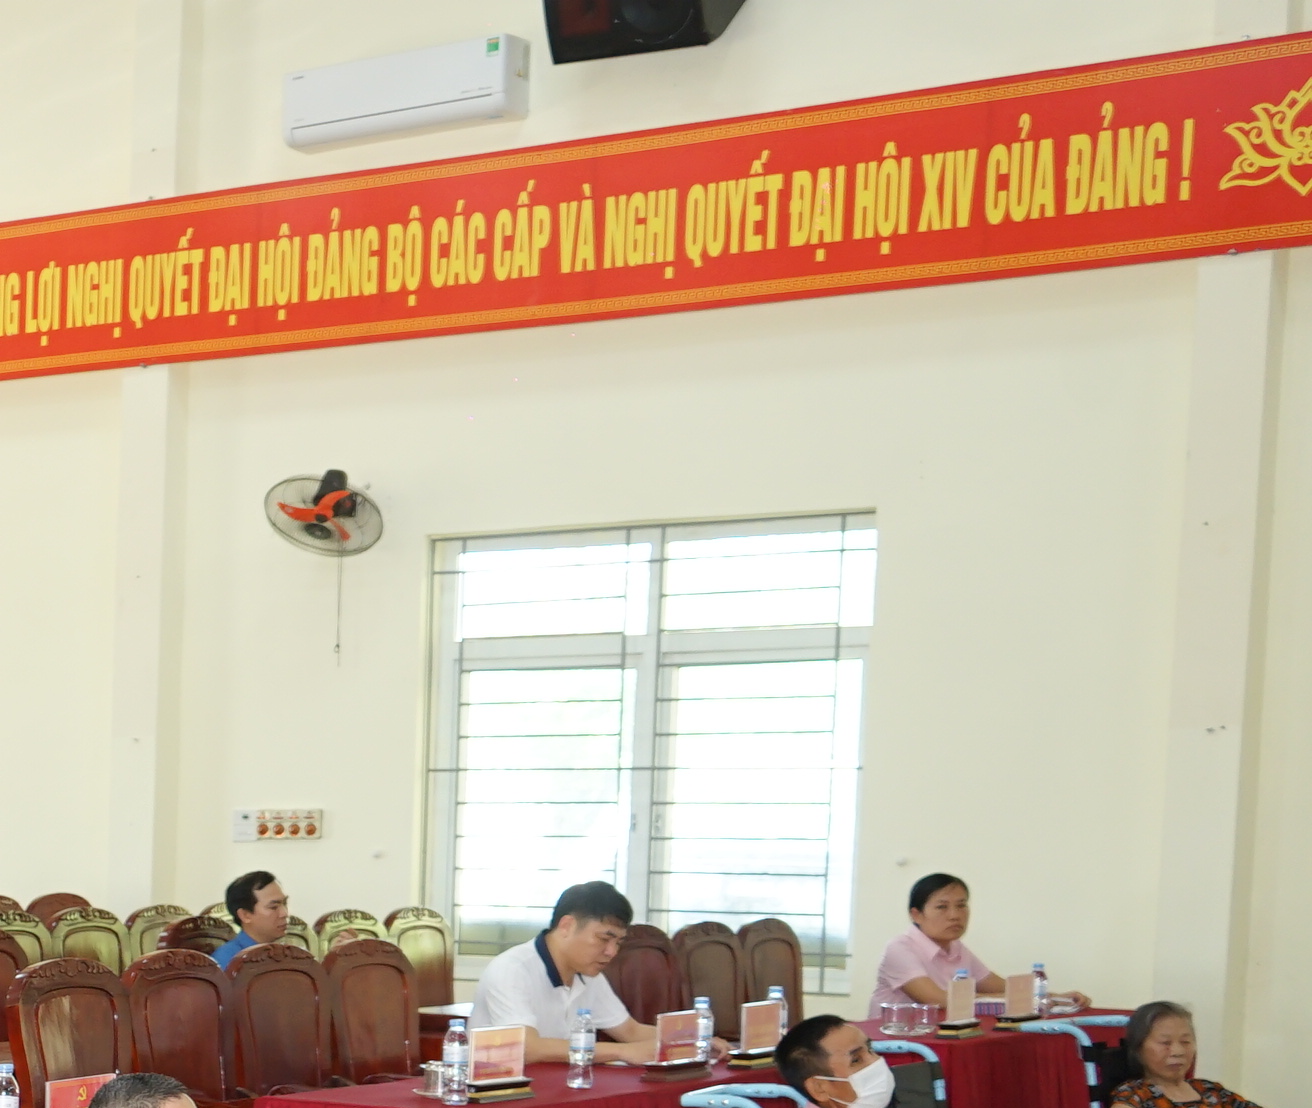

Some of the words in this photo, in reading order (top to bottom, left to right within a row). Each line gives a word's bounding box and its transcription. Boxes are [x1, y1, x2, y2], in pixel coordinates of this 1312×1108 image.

[25, 261, 62, 347] LỢI
[66, 258, 124, 338] NGHỊ
[128, 227, 205, 328] QUYẾT
[208, 242, 252, 326] ĐẠI
[257, 222, 301, 321] HỘI
[306, 207, 379, 302] ĐẢNG
[385, 205, 423, 307] BỘ
[429, 199, 486, 288] CÁC
[493, 179, 552, 281] CẤP
[559, 183, 596, 274] VÀ
[603, 187, 678, 279] NGHỊ
[684, 149, 784, 268] QUYẾT
[789, 165, 847, 262] ĐẠI
[853, 141, 912, 255] HỘI
[917, 148, 979, 232] XIV
[985, 113, 1055, 225] CỦA
[1065, 101, 1170, 216] ĐẢNG
